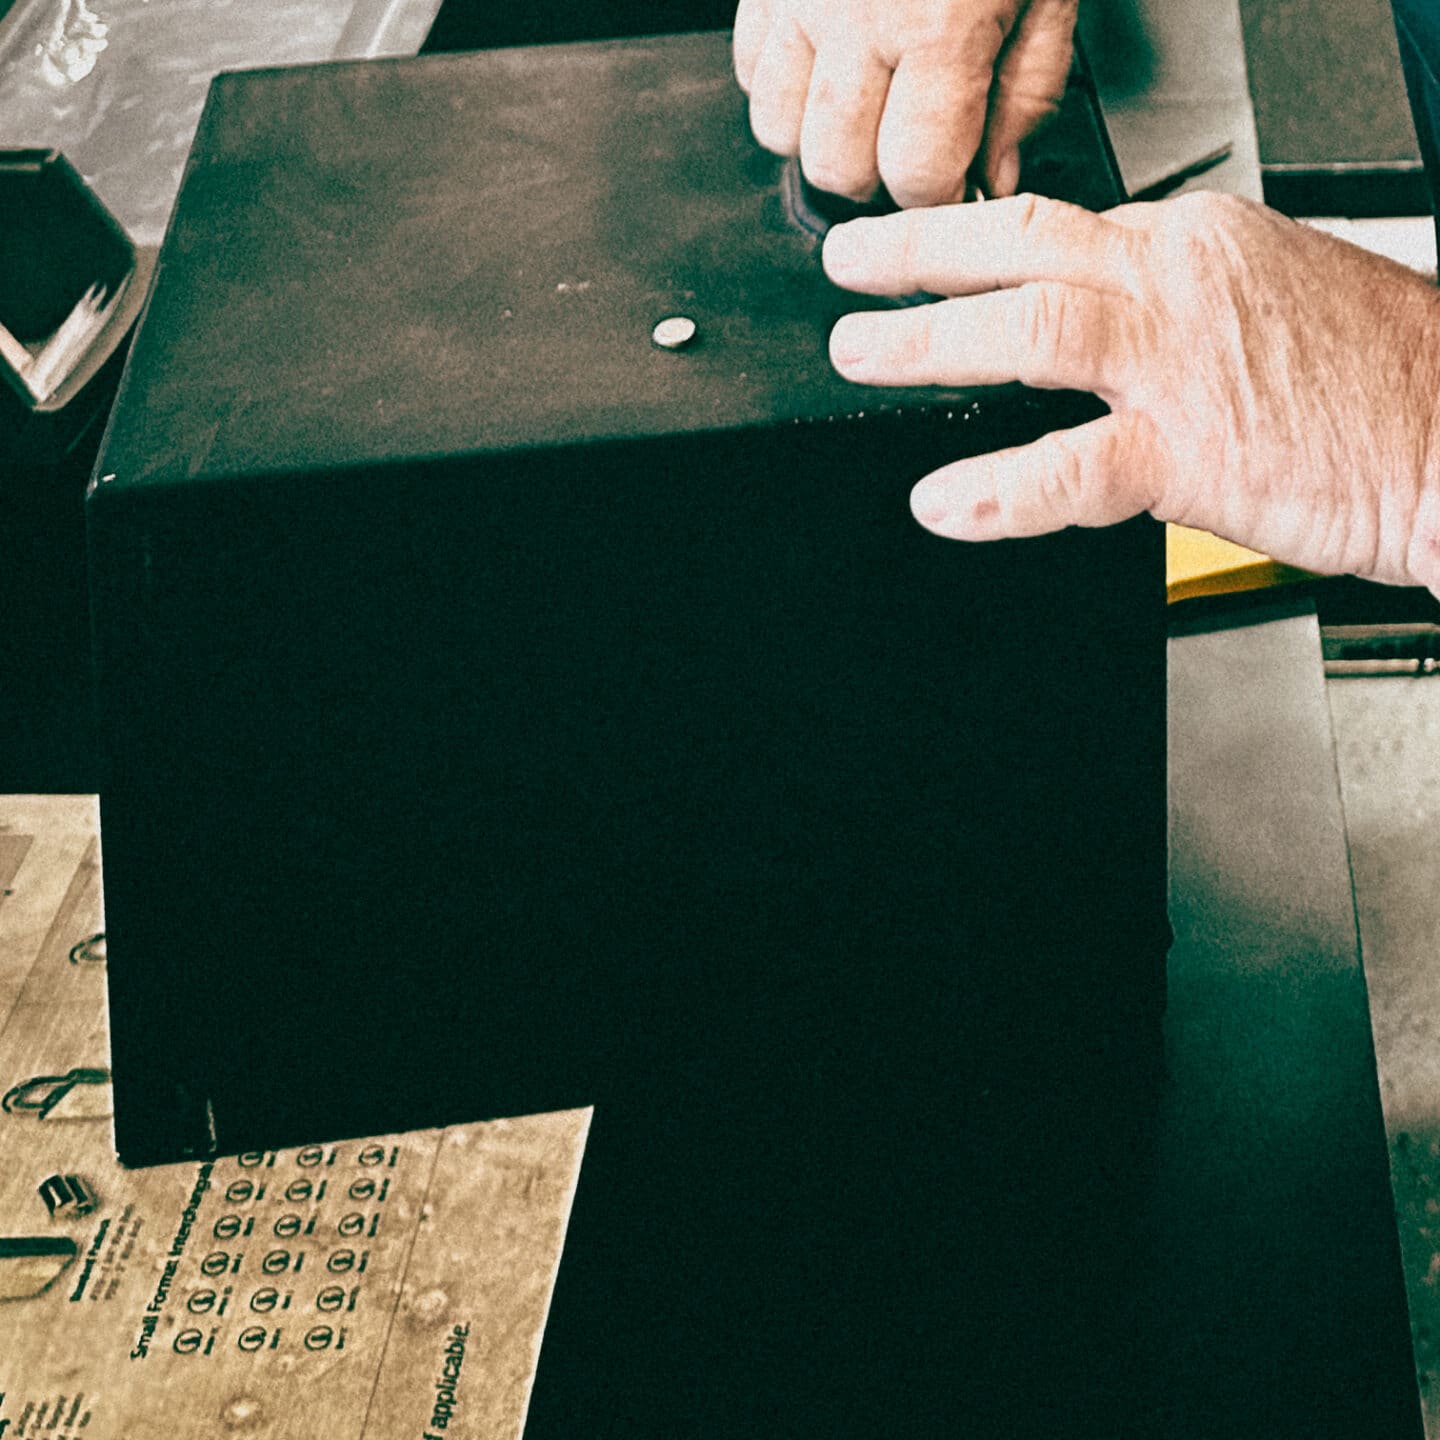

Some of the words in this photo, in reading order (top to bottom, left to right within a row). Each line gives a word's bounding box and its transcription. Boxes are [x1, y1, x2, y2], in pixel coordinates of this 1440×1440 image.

[130, 1316, 159, 1361] Small
[147, 1260, 179, 1312] Format
[431, 1321, 471, 1430] applicable.
